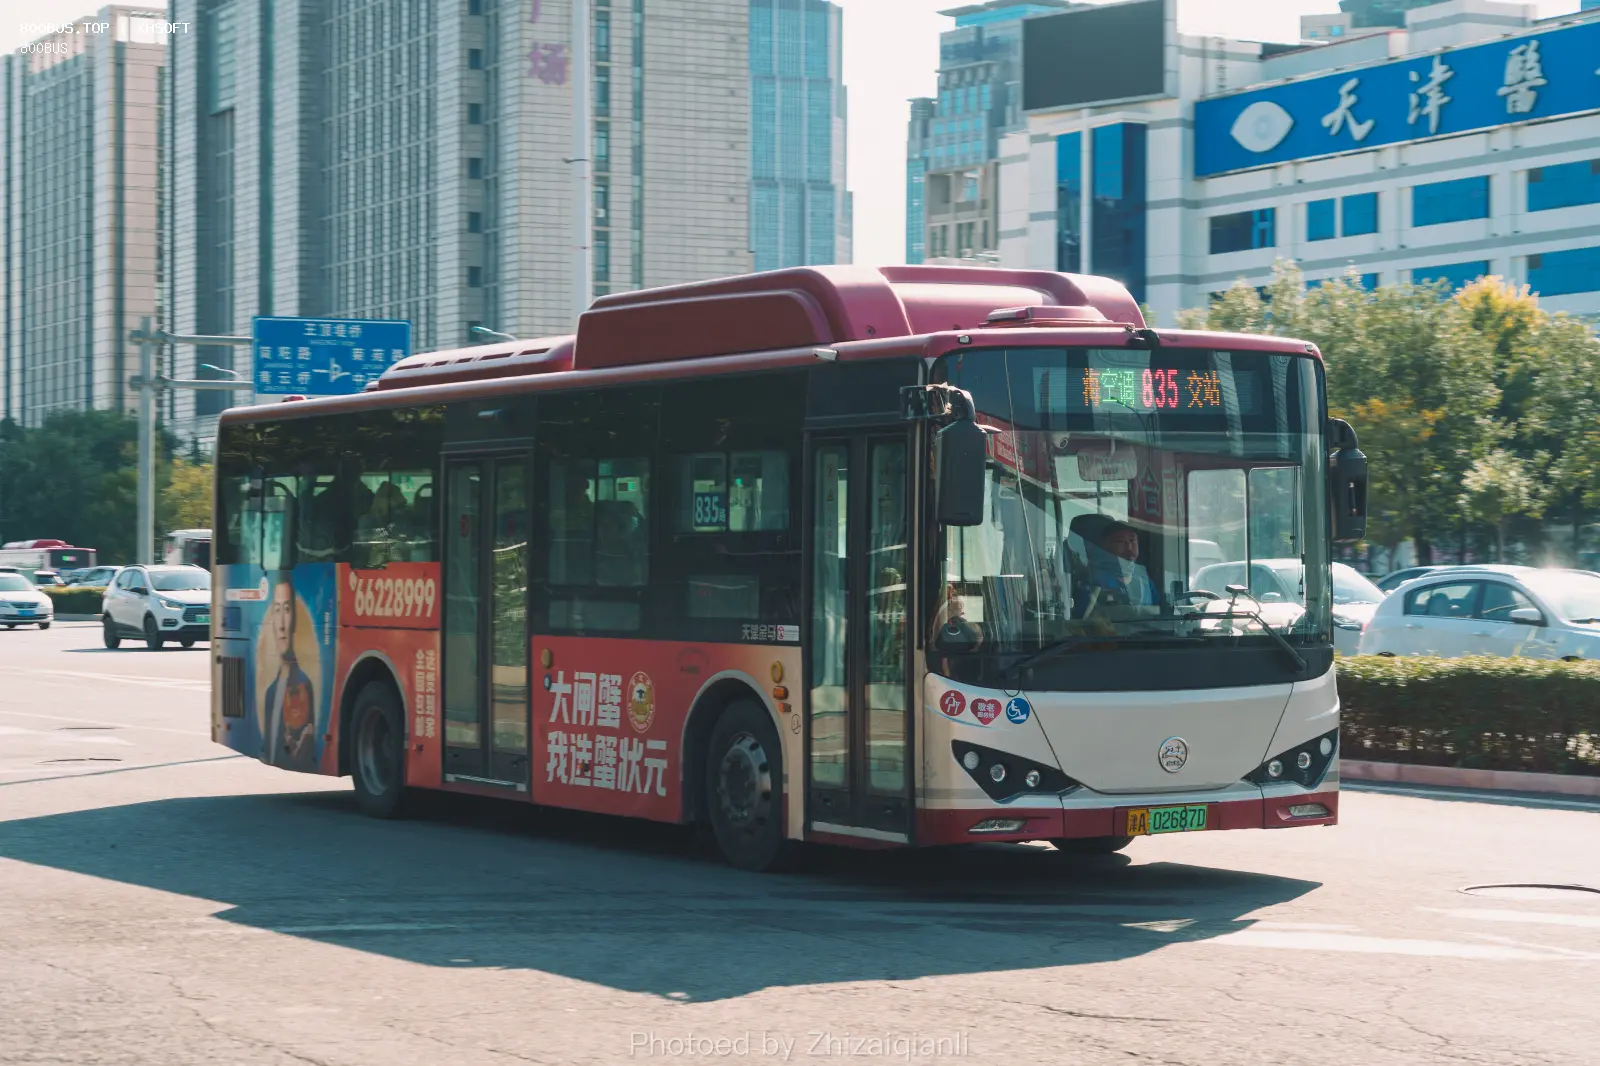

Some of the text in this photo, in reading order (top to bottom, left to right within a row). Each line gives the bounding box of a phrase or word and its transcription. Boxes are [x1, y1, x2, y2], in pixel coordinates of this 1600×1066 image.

[1321, 39, 1600, 142] 天津醫
[1141, 368, 1179, 409] 835
[355, 577, 436, 618] 66228999
[549, 670, 623, 729] 大闸蟹
[545, 730, 669, 798] 我选蟹状元
